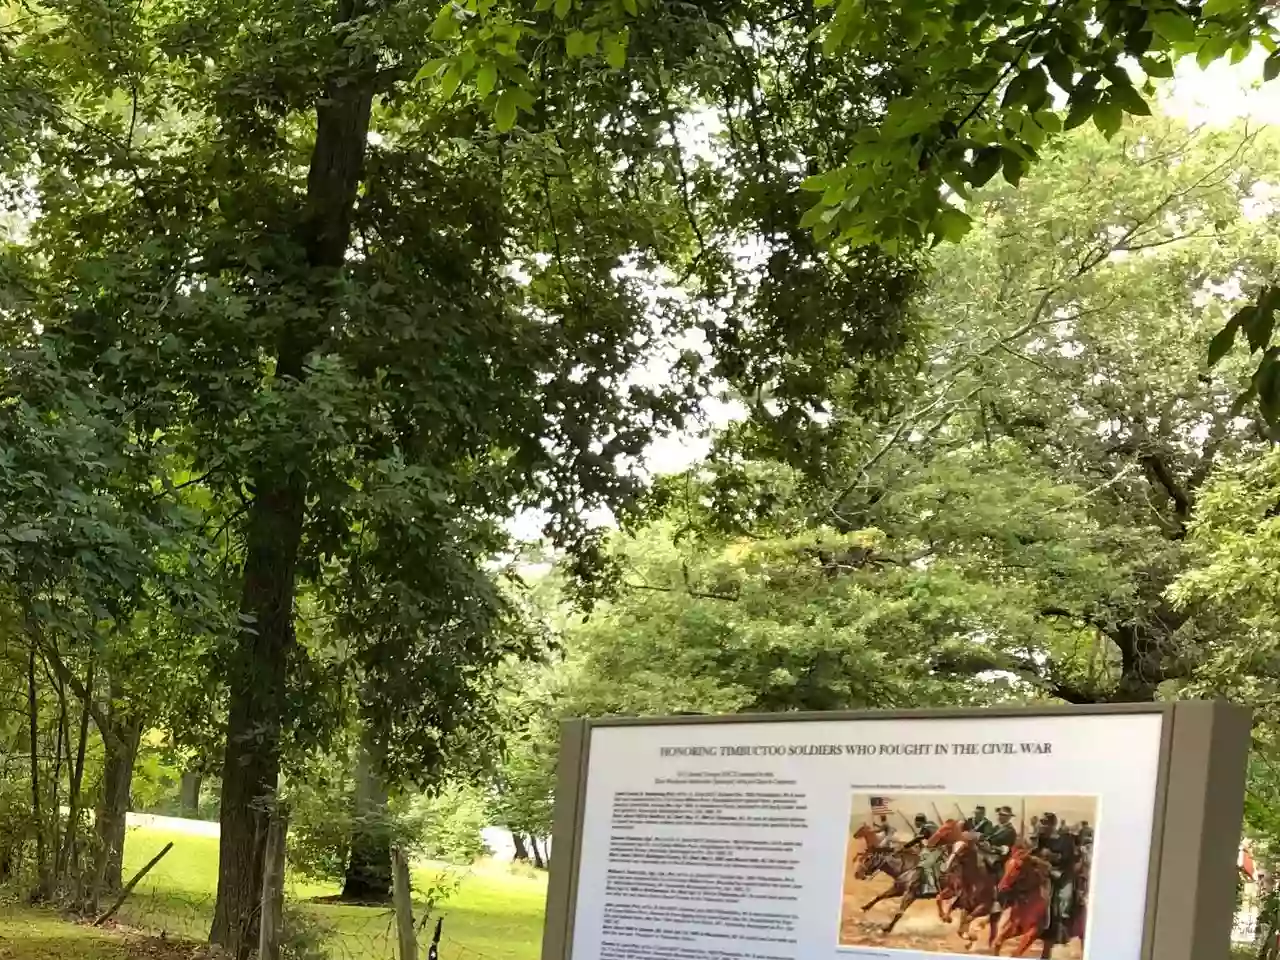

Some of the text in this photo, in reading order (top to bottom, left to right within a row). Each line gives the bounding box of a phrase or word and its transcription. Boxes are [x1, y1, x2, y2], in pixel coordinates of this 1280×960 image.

[660, 742, 1052, 757] HONORING TIMBUCTOO SOLDIERS WHO FOUGHT IN THE CIVIL WAR
